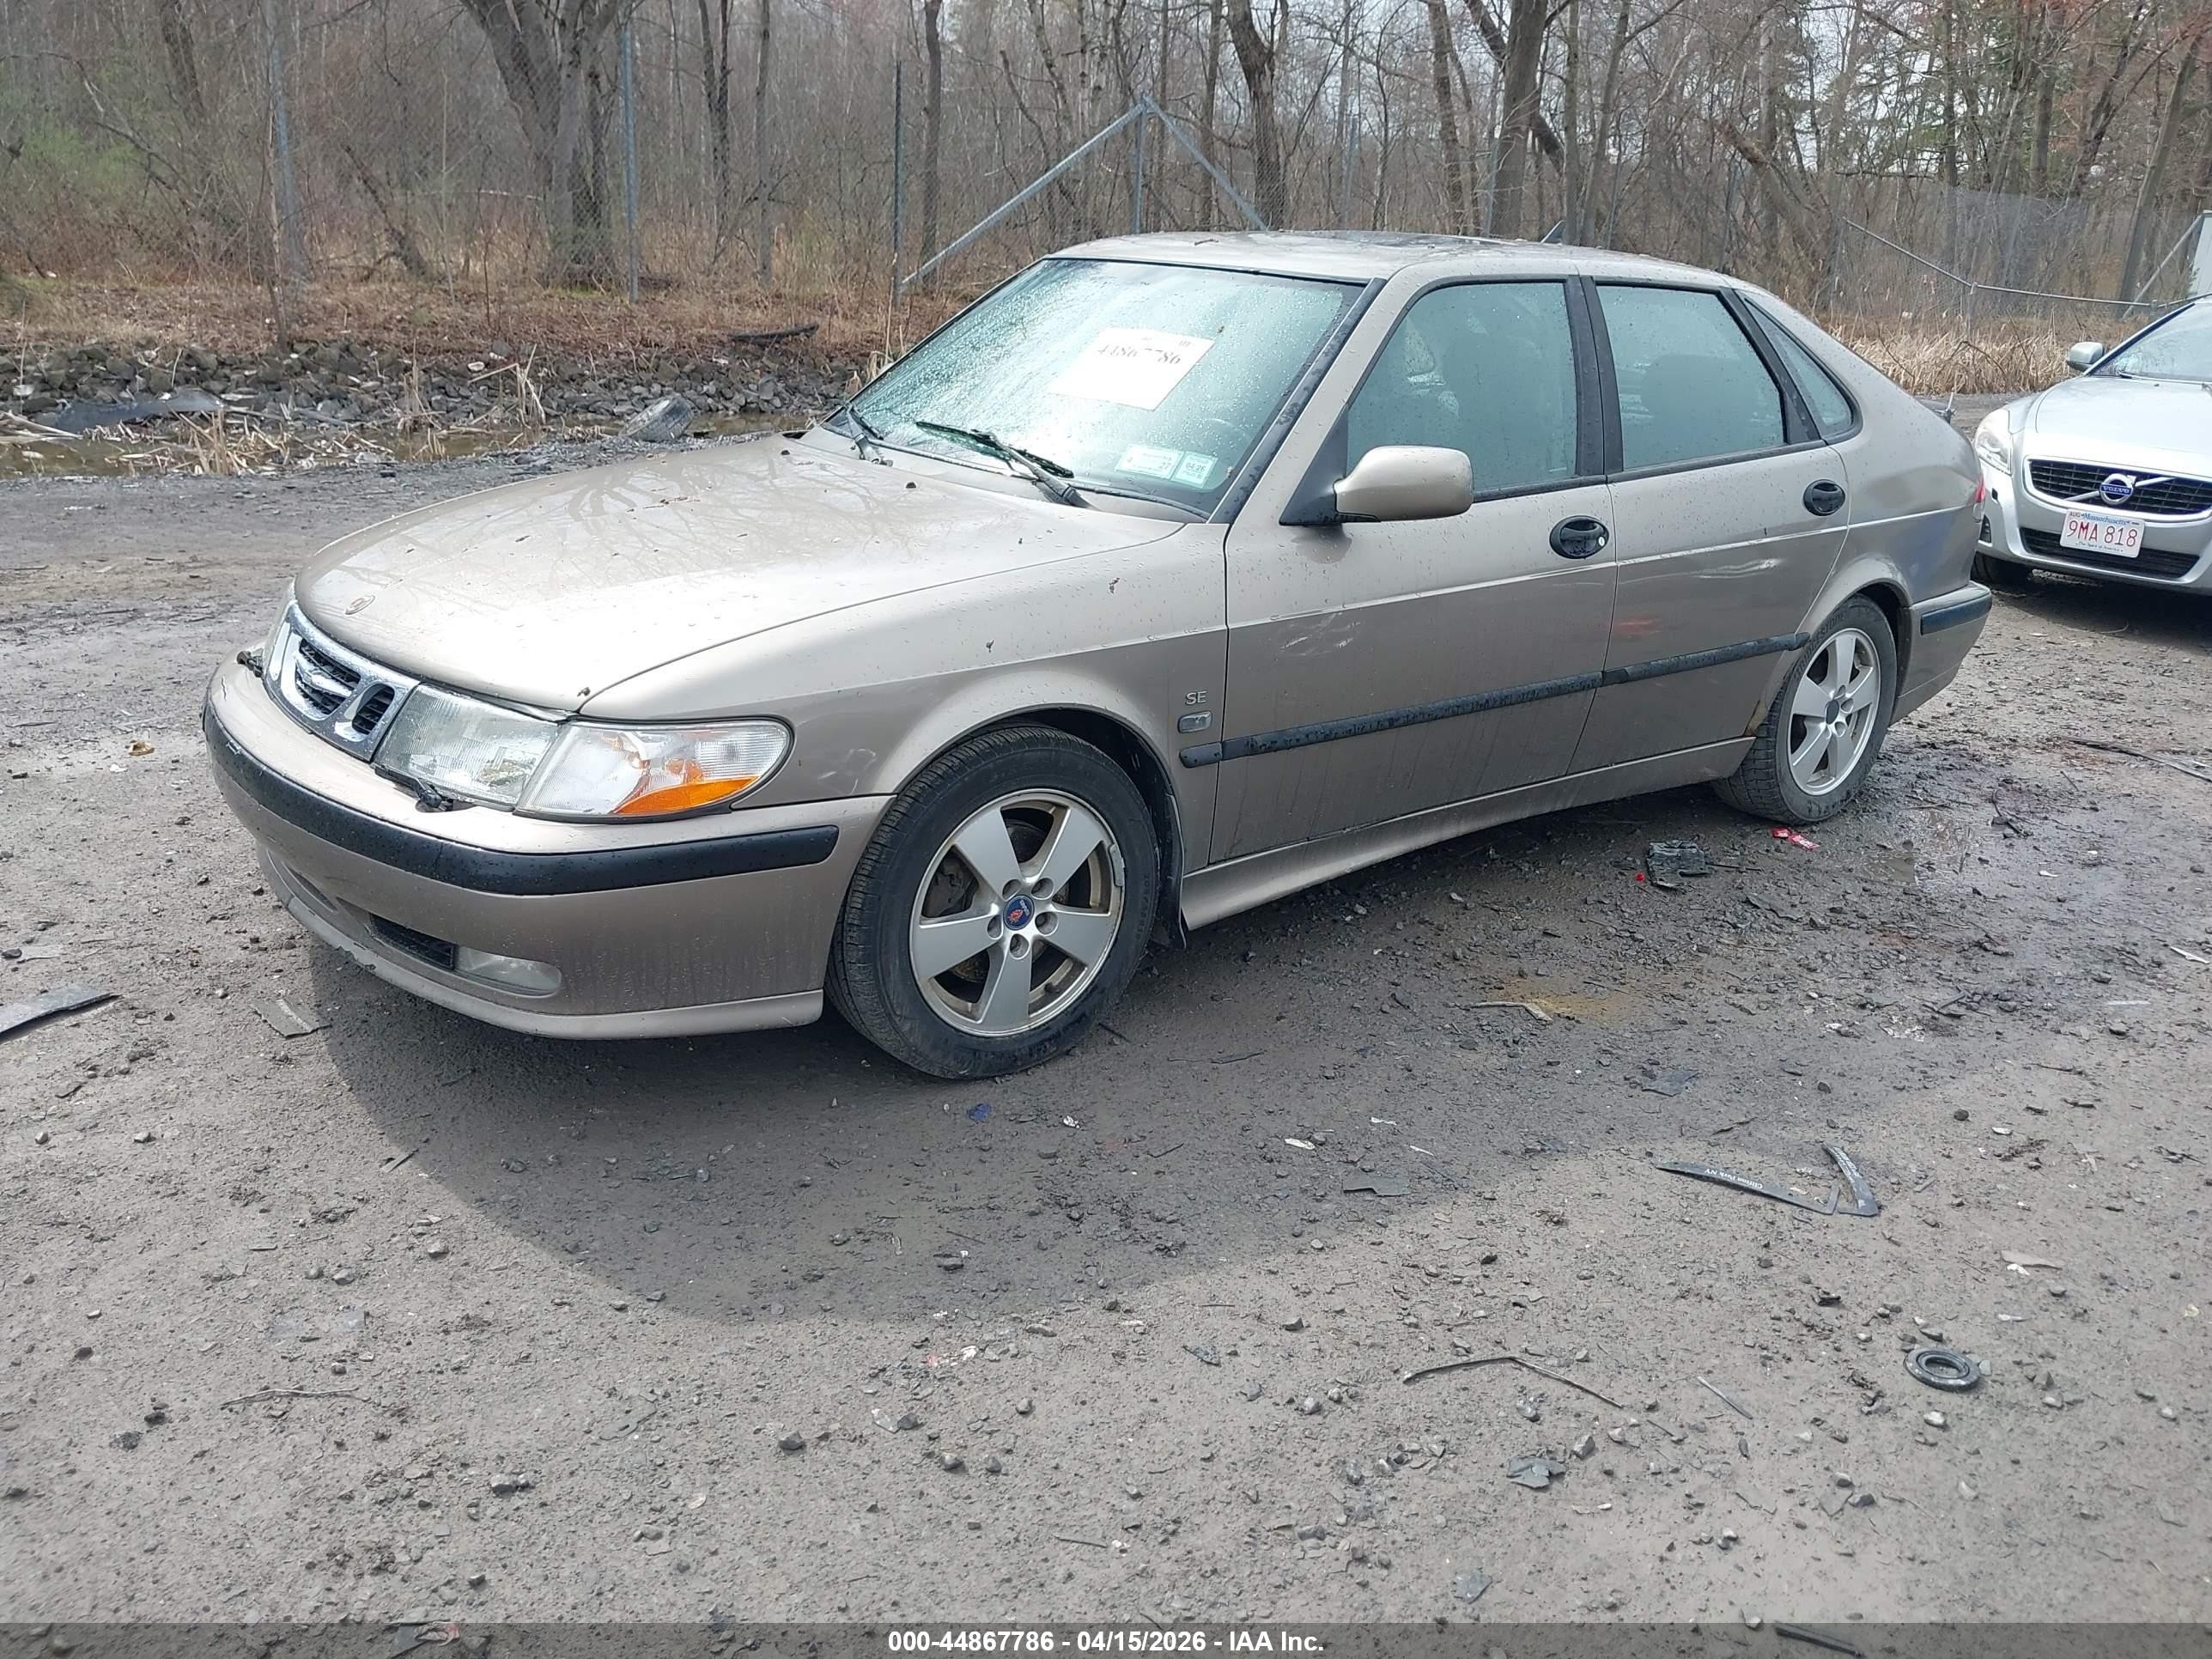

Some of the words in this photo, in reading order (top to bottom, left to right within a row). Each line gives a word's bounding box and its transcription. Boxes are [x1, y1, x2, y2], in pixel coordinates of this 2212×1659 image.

[2084, 514, 2128, 525] Massachusetts
[2067, 520, 2098, 542] 9MA
[2104, 526, 2138, 547] 818
[1185, 690, 1207, 706] SE
[1719, 1171, 1735, 1181] Park
